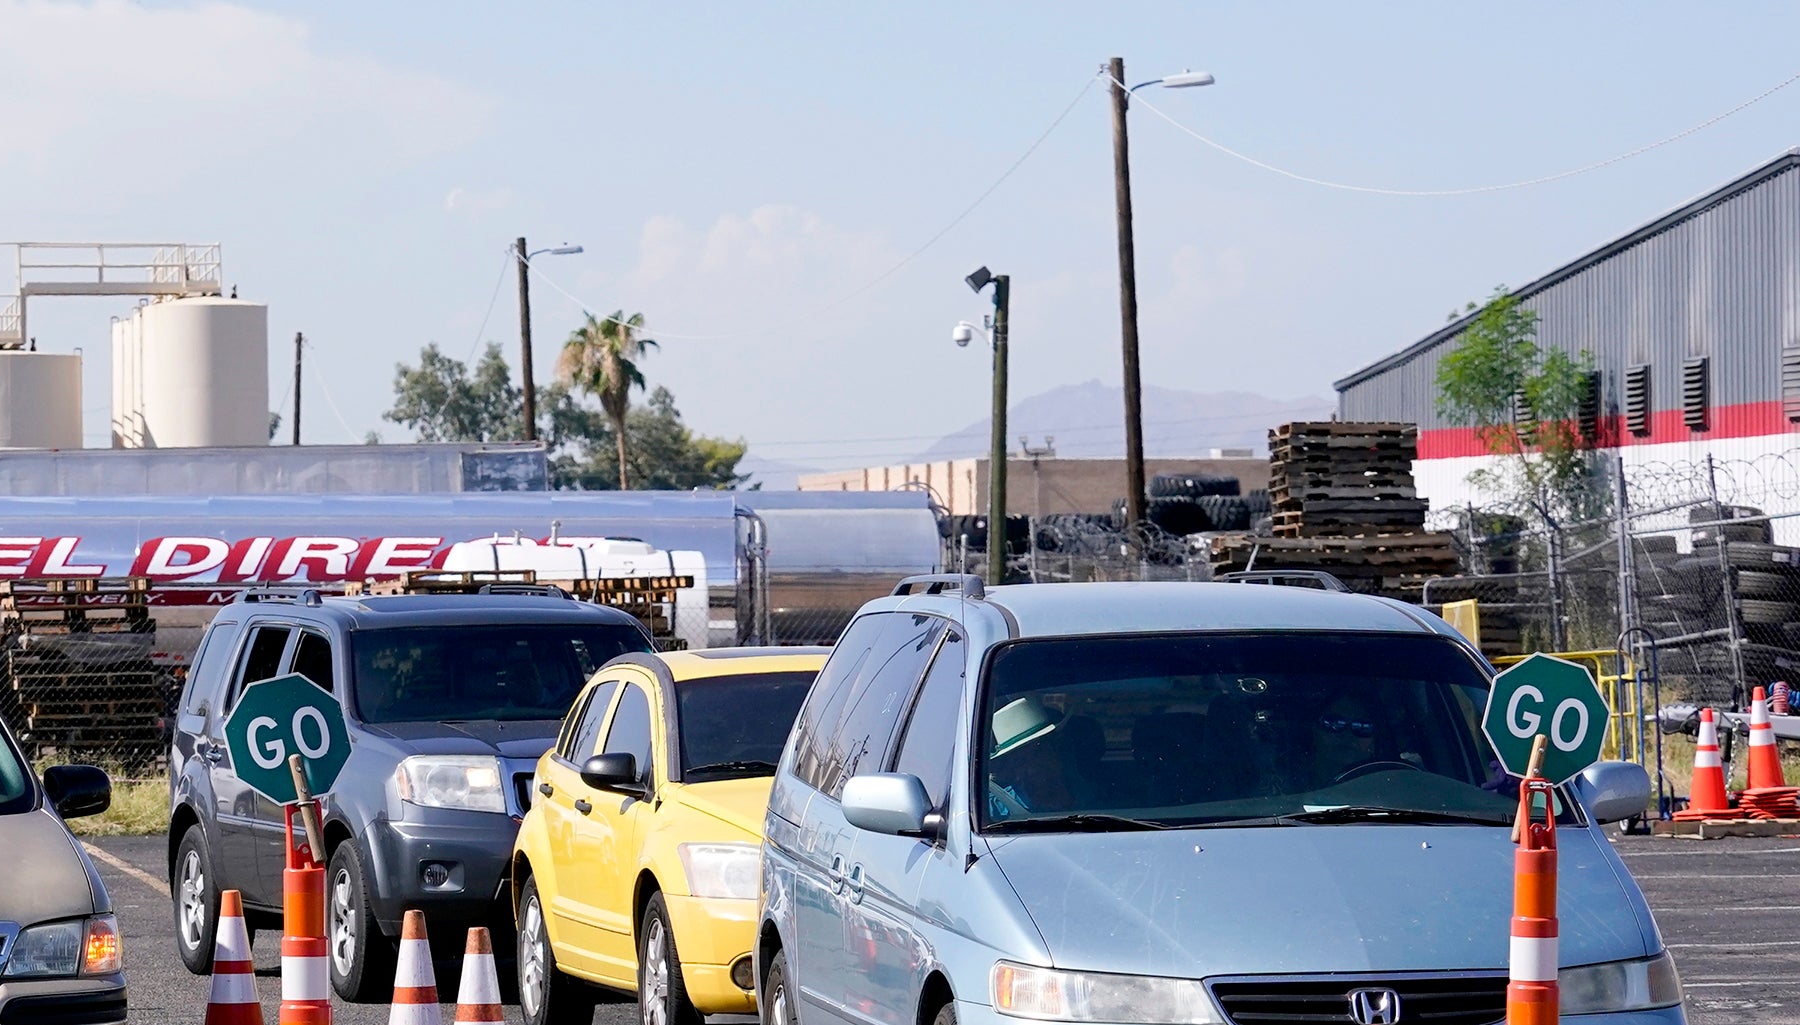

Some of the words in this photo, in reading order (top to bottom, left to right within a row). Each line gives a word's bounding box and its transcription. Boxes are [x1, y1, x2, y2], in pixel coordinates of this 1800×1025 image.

[130, 536, 602, 582] DIRE
[246, 706, 331, 770] GO
[1506, 684, 1589, 752] GO
